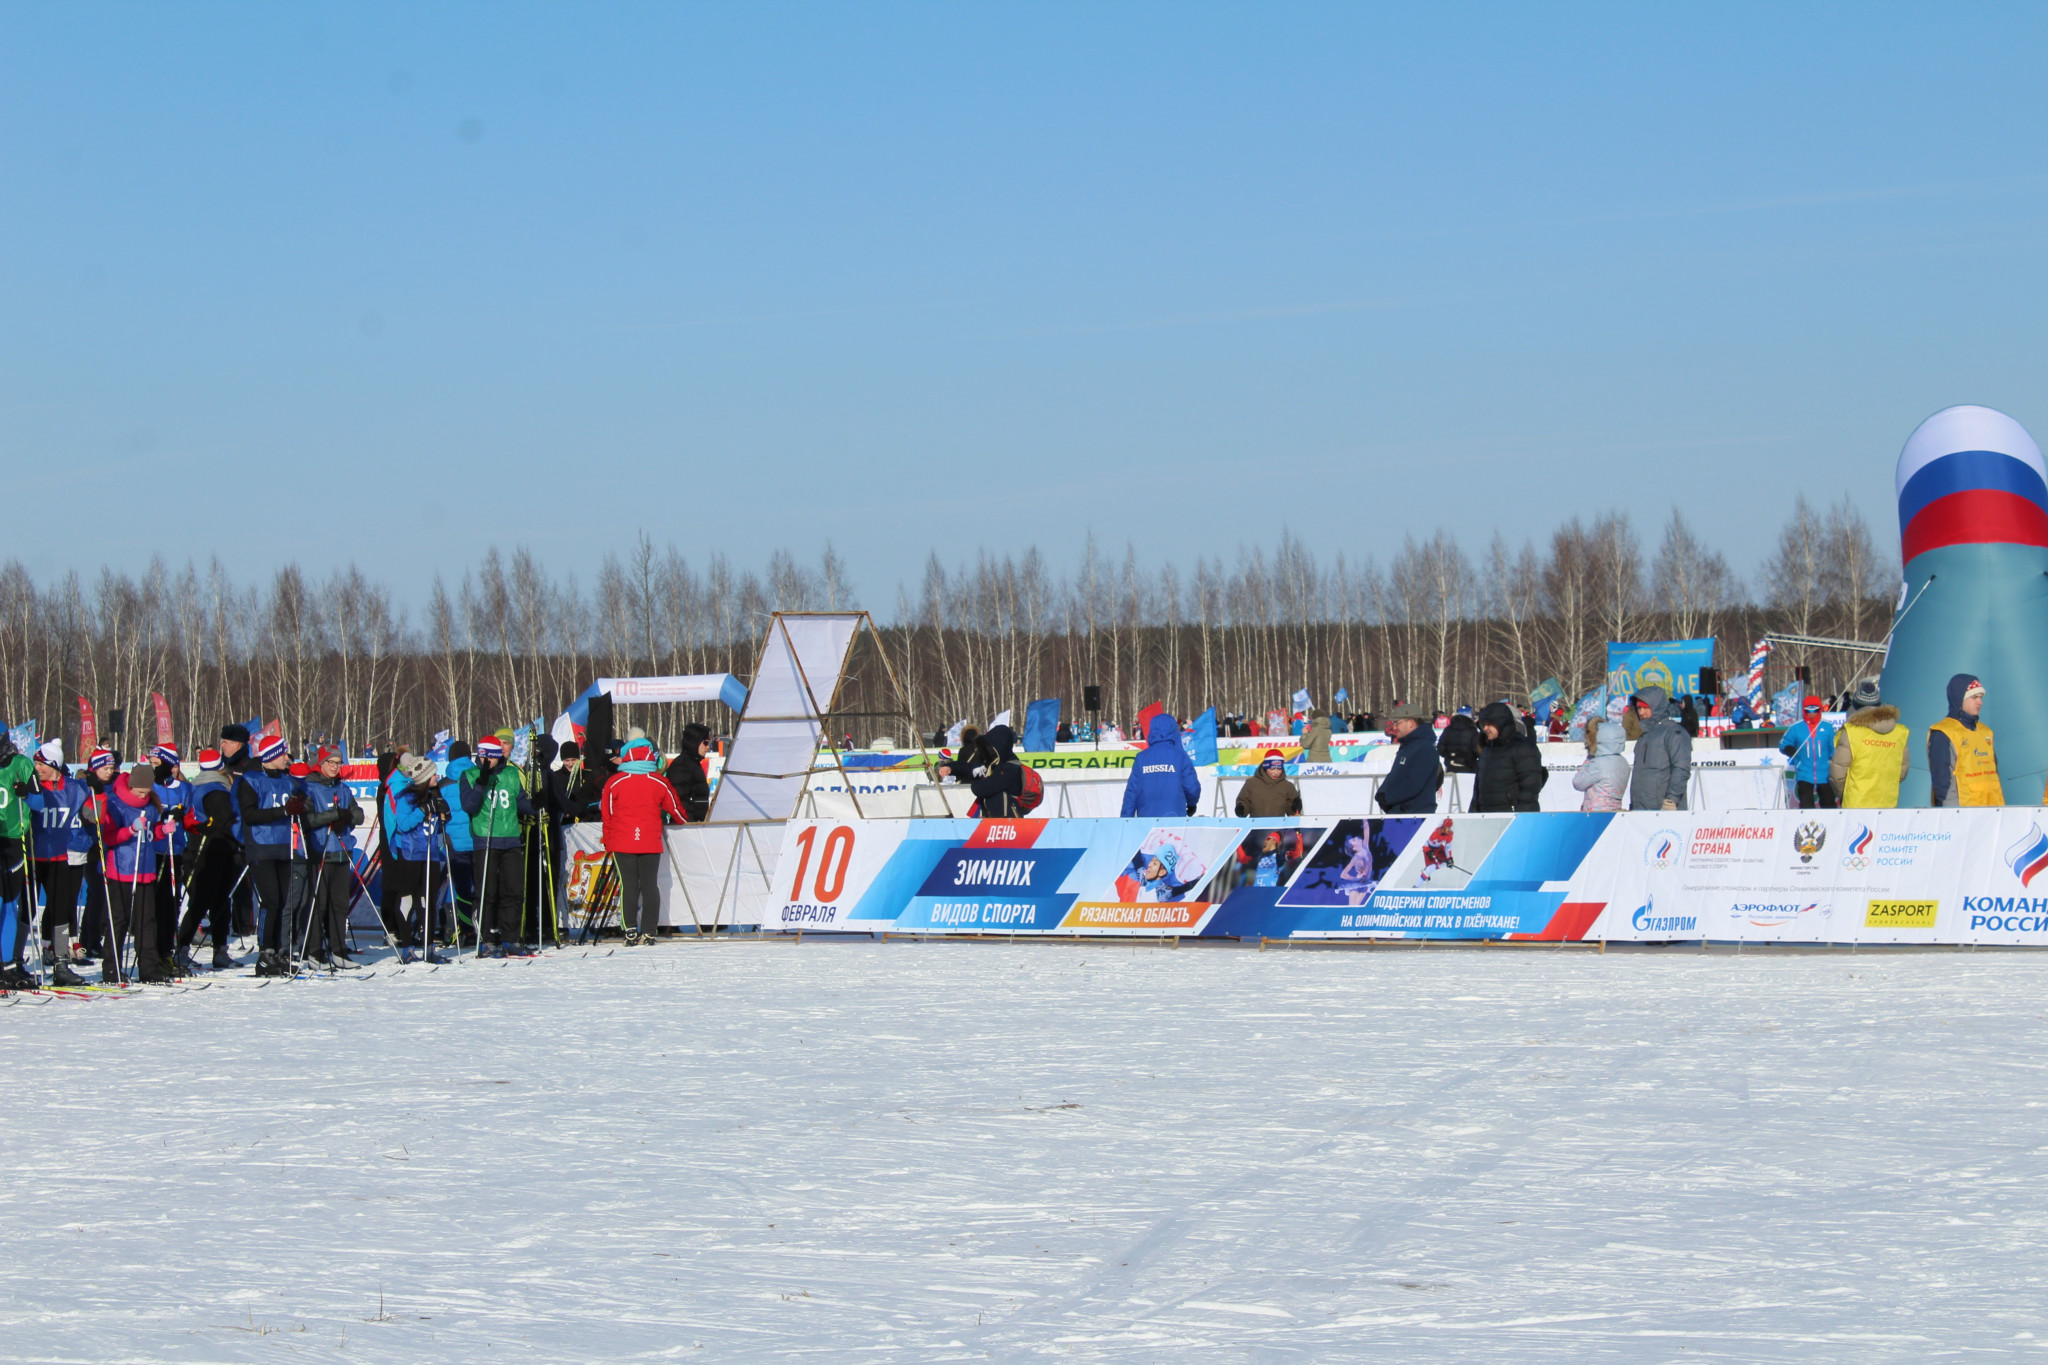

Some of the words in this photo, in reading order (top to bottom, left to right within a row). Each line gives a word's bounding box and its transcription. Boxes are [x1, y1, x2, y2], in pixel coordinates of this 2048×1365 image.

[615, 681, 639, 696] ГТО
[1677, 674, 1699, 694] ЛЕ
[1862, 739, 1897, 748] ОССПОРТ
[1142, 764, 1176, 774] RUSSIA
[41, 807, 70, 828] 117
[986, 825, 1017, 843] ДЕНЬ
[1695, 824, 1774, 840] ОЛИМПИЙСКАЯ
[1880, 832, 1952, 841] ОЛИМПИЙСКИЙ
[1691, 843, 1731, 855] СТРАНА
[1878, 845, 1918, 854] КОМИТЕТ
[790, 825, 856, 903] 10
[1876, 857, 1913, 866] РОССИИ
[954, 859, 1036, 886] ЗИМНИХ
[1373, 895, 1425, 910] ПОДДЕРЖИ
[1427, 896, 1492, 909] СПОРТСМЕНОВ
[1730, 903, 1801, 912] АЭРОФЛОТ
[1870, 904, 1934, 917] ZASPORT
[1962, 896, 2048, 914] КОМАН
[781, 904, 837, 923] ФЕВРАЛЯ
[930, 903, 979, 926] ВИДОВ
[981, 903, 1037, 924] СПОРТА
[1079, 907, 1143, 923] РЯЗАНСКАЯ
[1143, 907, 1190, 923] ОБЛАСТЬ
[1340, 915, 1353, 927] НА
[1355, 912, 1422, 928] ОЛИМПИЙСКИХ
[1423, 915, 1454, 928] ИГРАХ
[1455, 916, 1461, 928] В
[1463, 913, 1520, 928] ПХЁНЧХАНЕ!
[1650, 916, 1697, 931] ГАЗПРОМ
[1970, 915, 2048, 932] РОССИ
